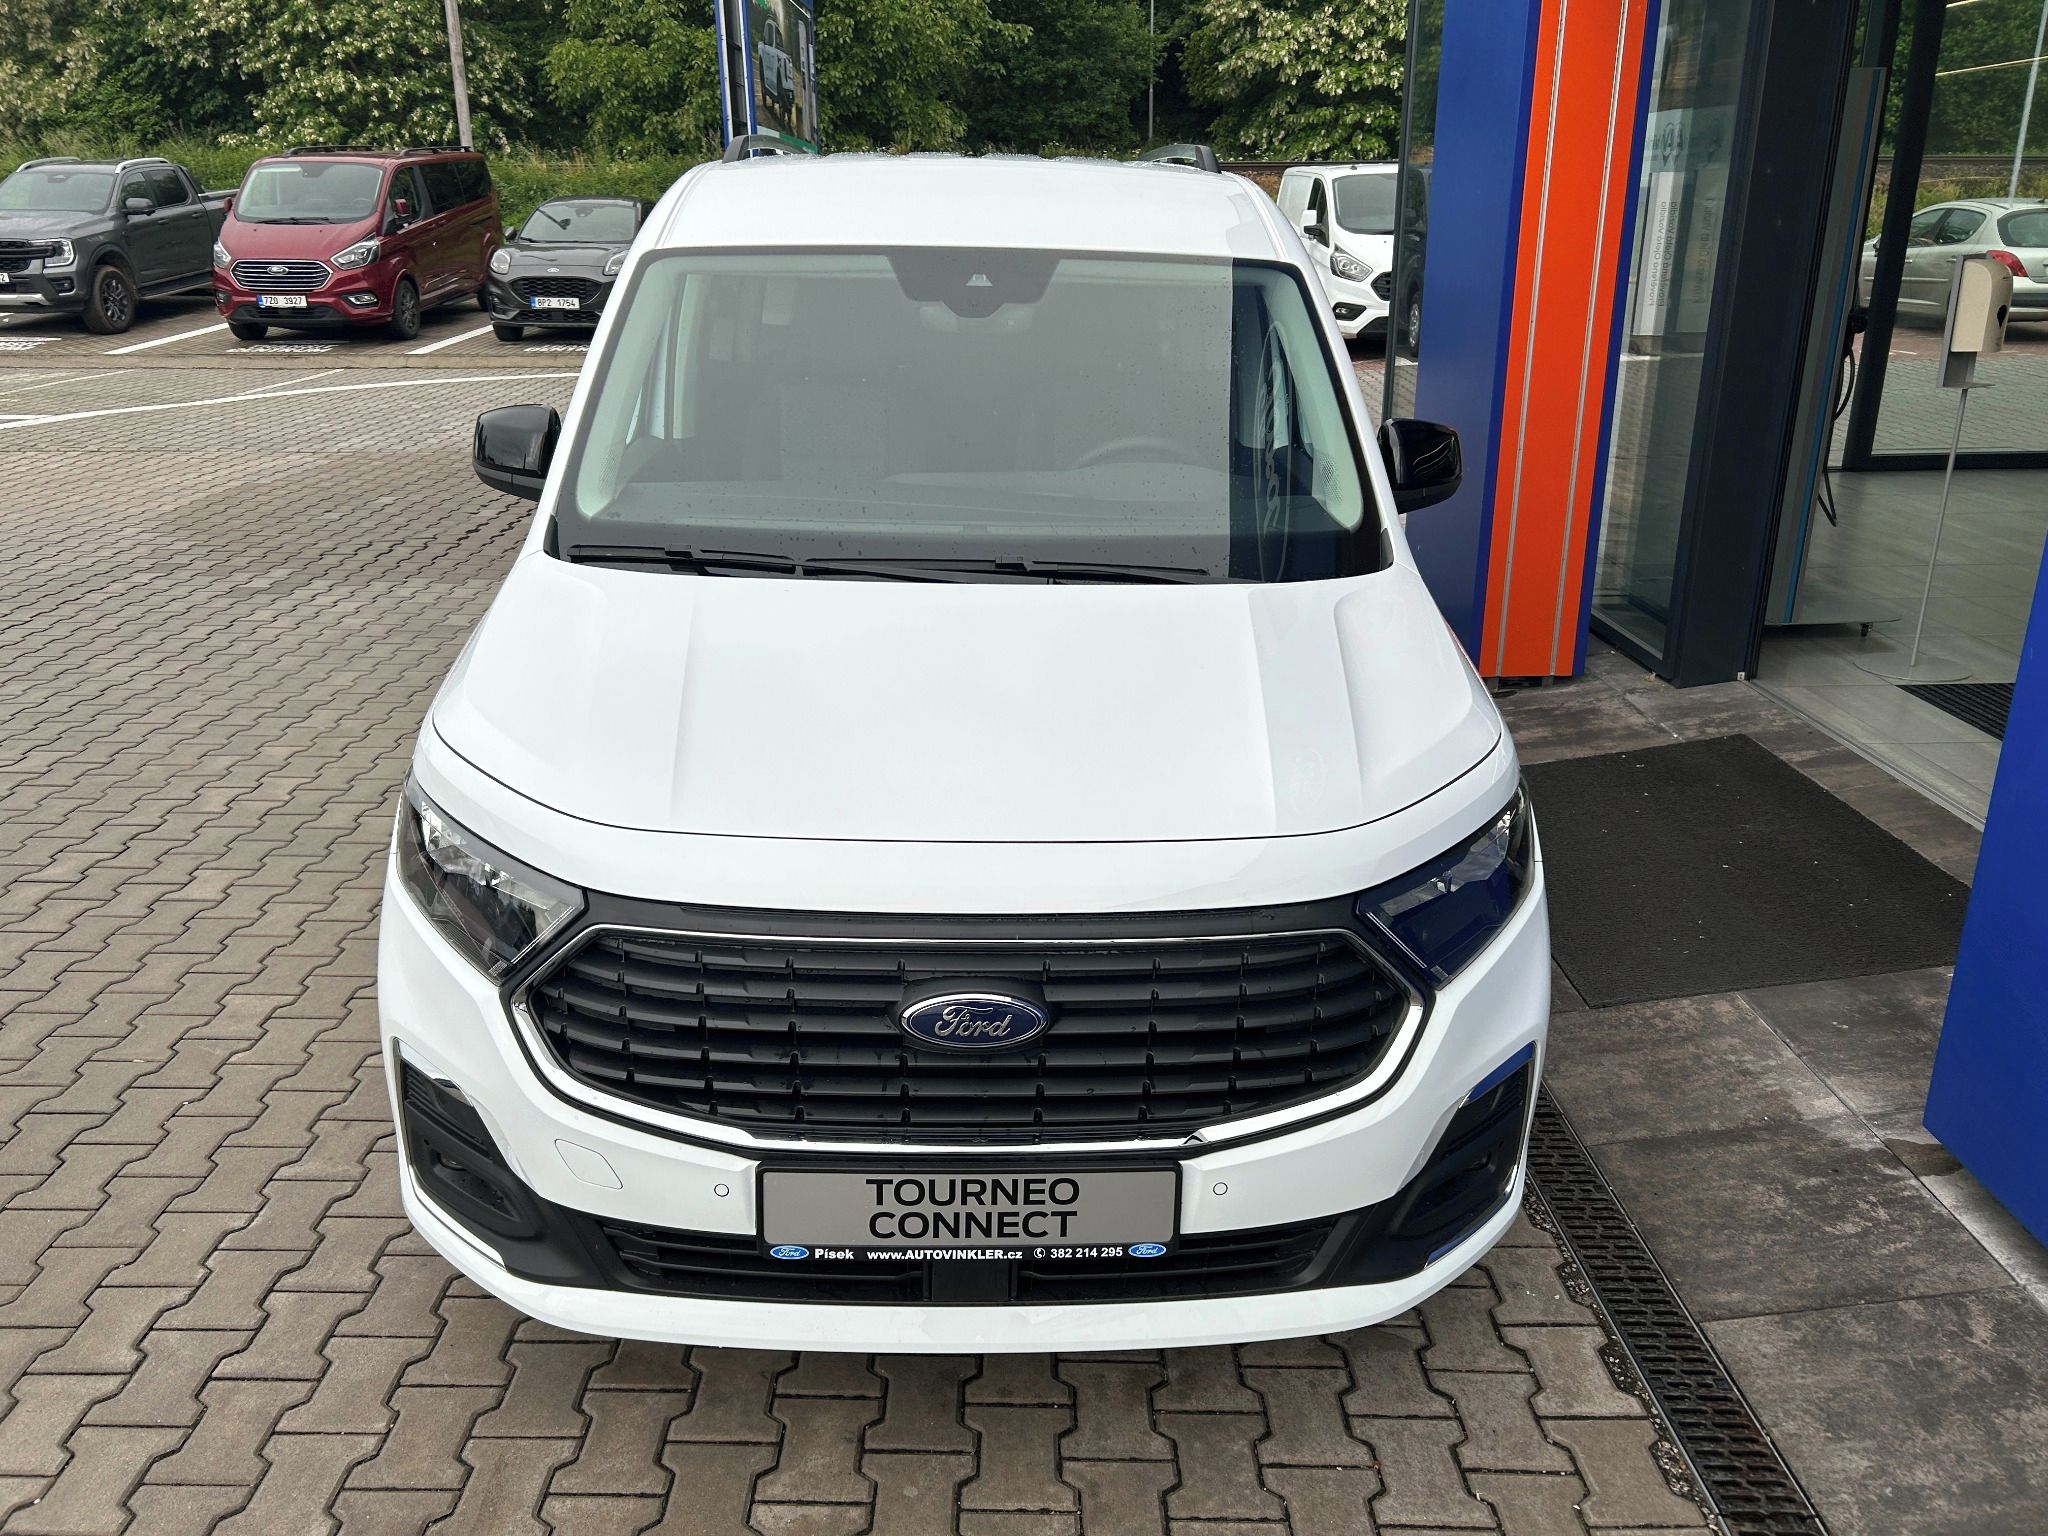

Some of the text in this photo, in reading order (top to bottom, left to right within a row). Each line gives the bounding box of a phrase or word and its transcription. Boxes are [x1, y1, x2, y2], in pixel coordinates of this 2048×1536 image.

[284, 296, 302, 305] 3927
[558, 299, 576, 307] 1754
[934, 1005, 1013, 1038] Ford
[865, 1178, 1080, 1207] TOURNEO
[868, 1211, 1078, 1239] CONNECT
[814, 1248, 855, 1260] Písek
[867, 1249, 1023, 1260] www.AUTOVINKLER.cz
[1050, 1248, 1073, 1259] 382
[1075, 1247, 1098, 1258] 214
[1100, 1247, 1123, 1258] 295
